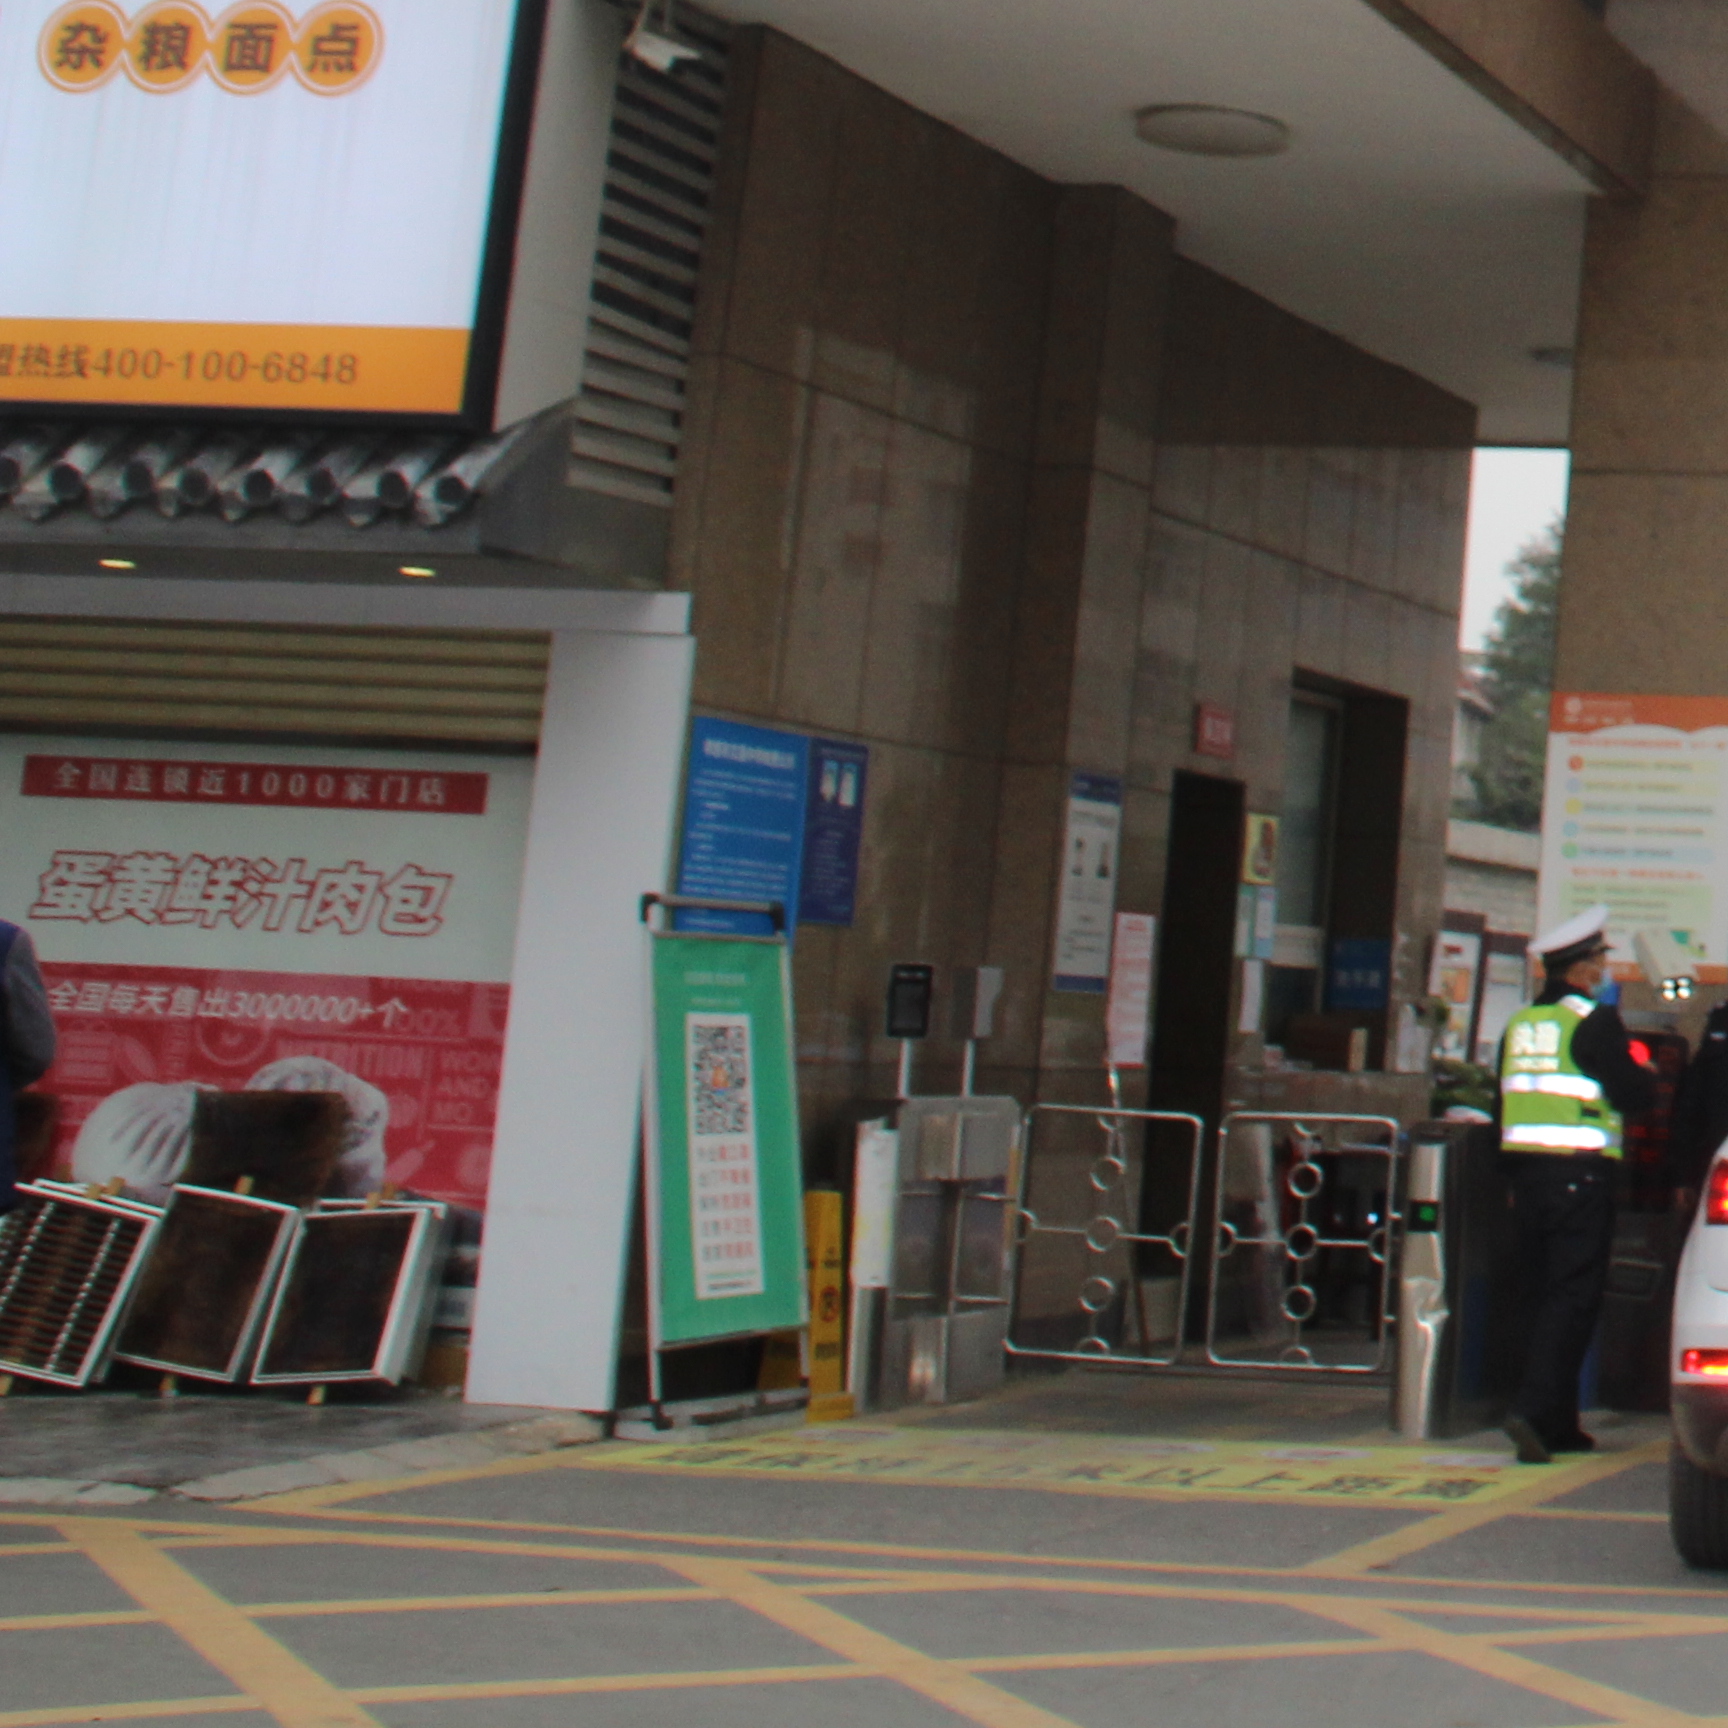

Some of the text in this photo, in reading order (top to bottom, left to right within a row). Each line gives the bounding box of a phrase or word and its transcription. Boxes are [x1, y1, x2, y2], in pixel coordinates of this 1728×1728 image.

[54, 20, 362, 77] 杂粮面点
[29, 849, 453, 937] 蛋黄鲜汁肉包
